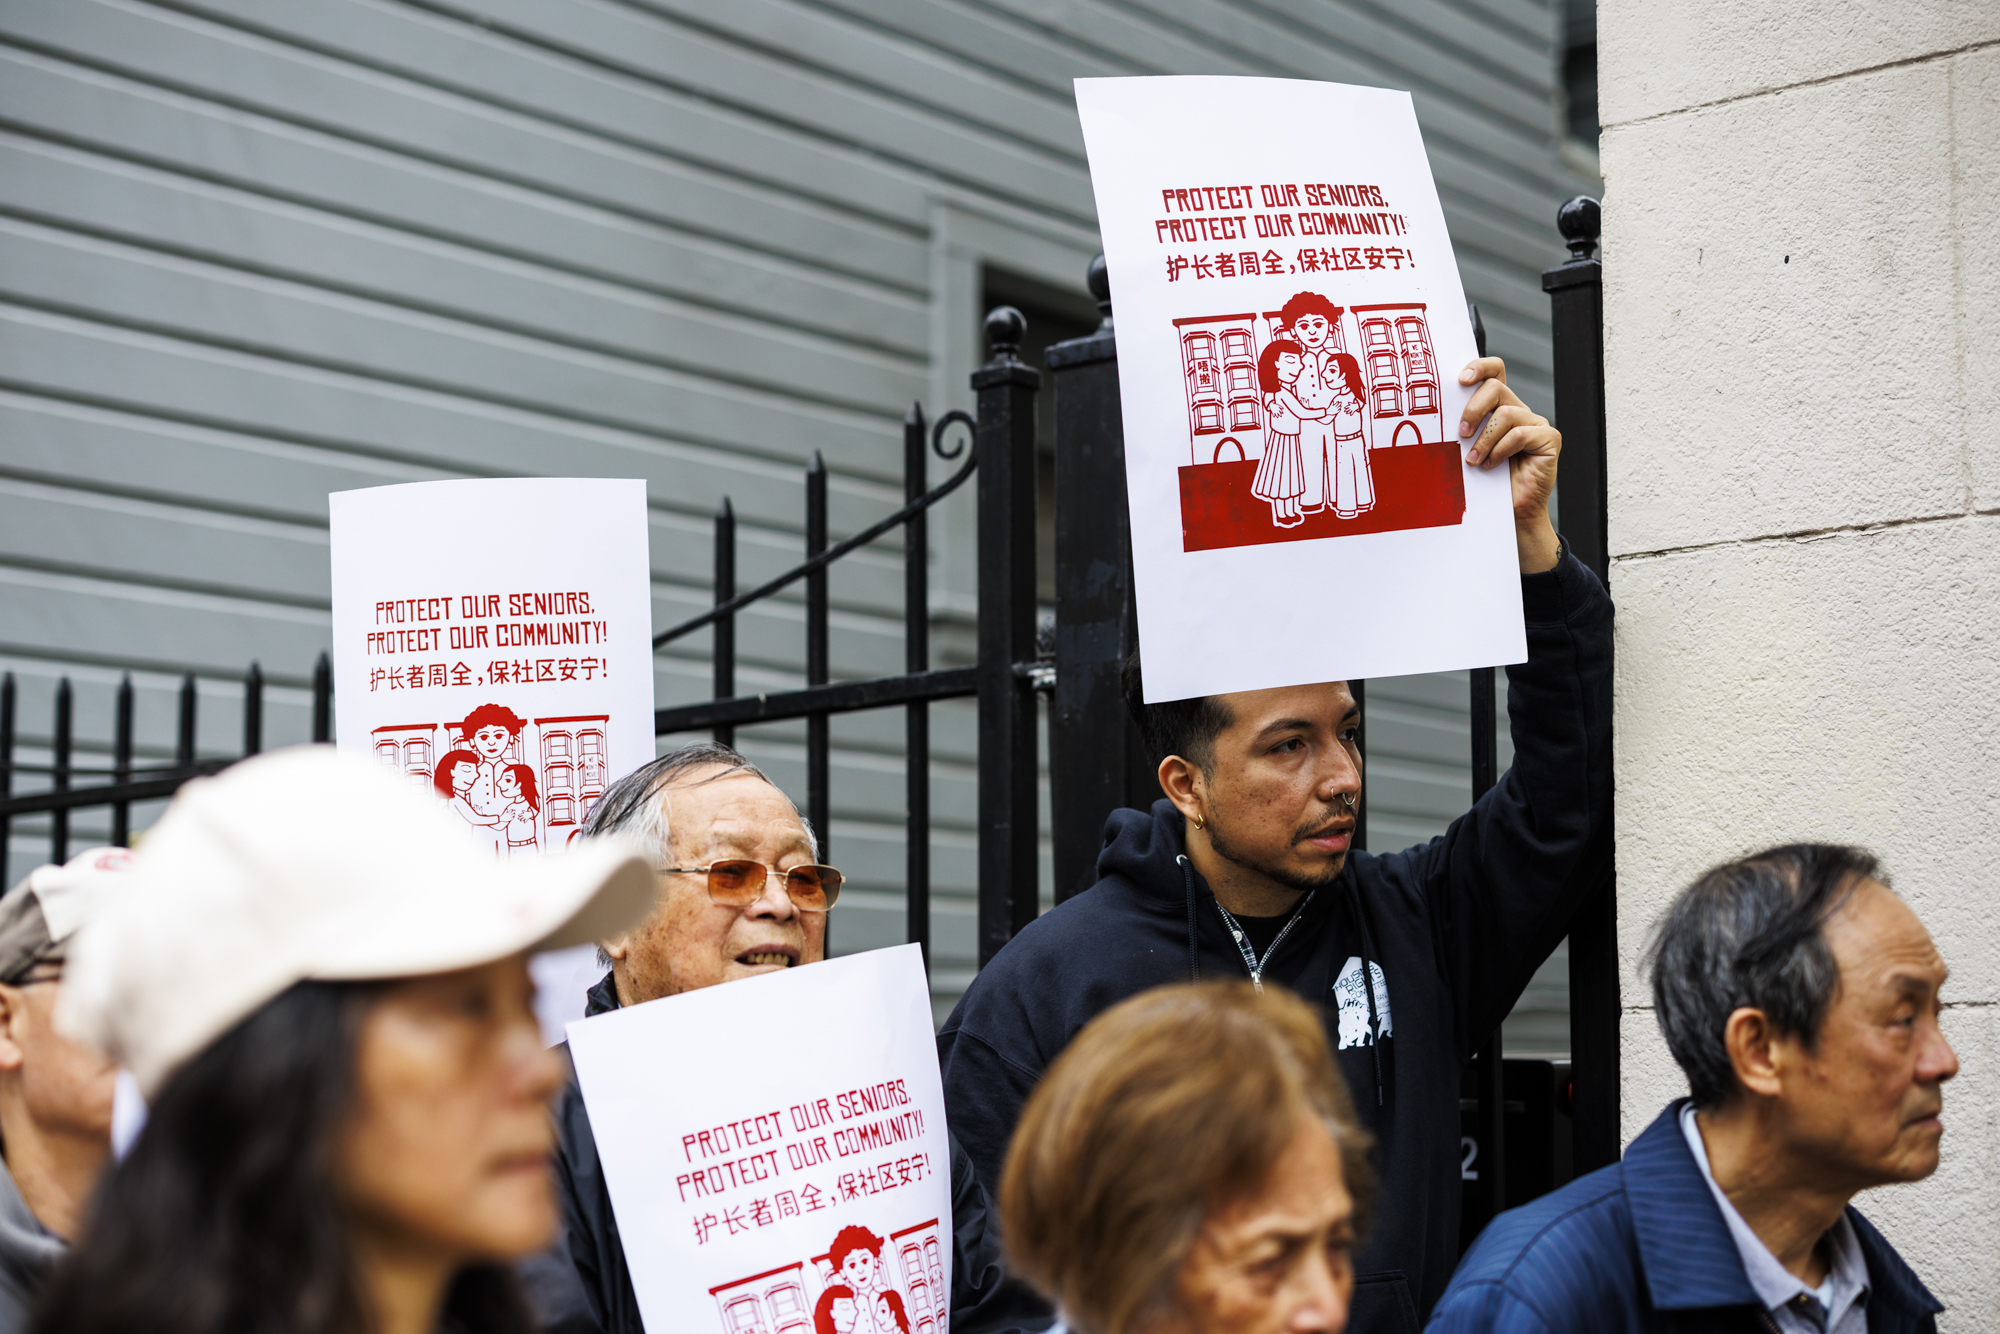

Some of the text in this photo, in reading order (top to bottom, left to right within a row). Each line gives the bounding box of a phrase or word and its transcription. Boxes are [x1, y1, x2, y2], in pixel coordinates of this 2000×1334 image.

[1162, 184, 1388, 213] PROTECT OUR SENIORS,
[1155, 213, 1406, 243] PROTECT OUR COMMUNITY!
[376, 592, 594, 624] PROTECT OUR SENIORS,
[368, 621, 606, 654] PROTECT OUR COMMUNITY!
[682, 1079, 911, 1162] PROTECT OUR SENIORS,
[676, 1110, 924, 1202] PROTECT OUR COMMUNITY!
